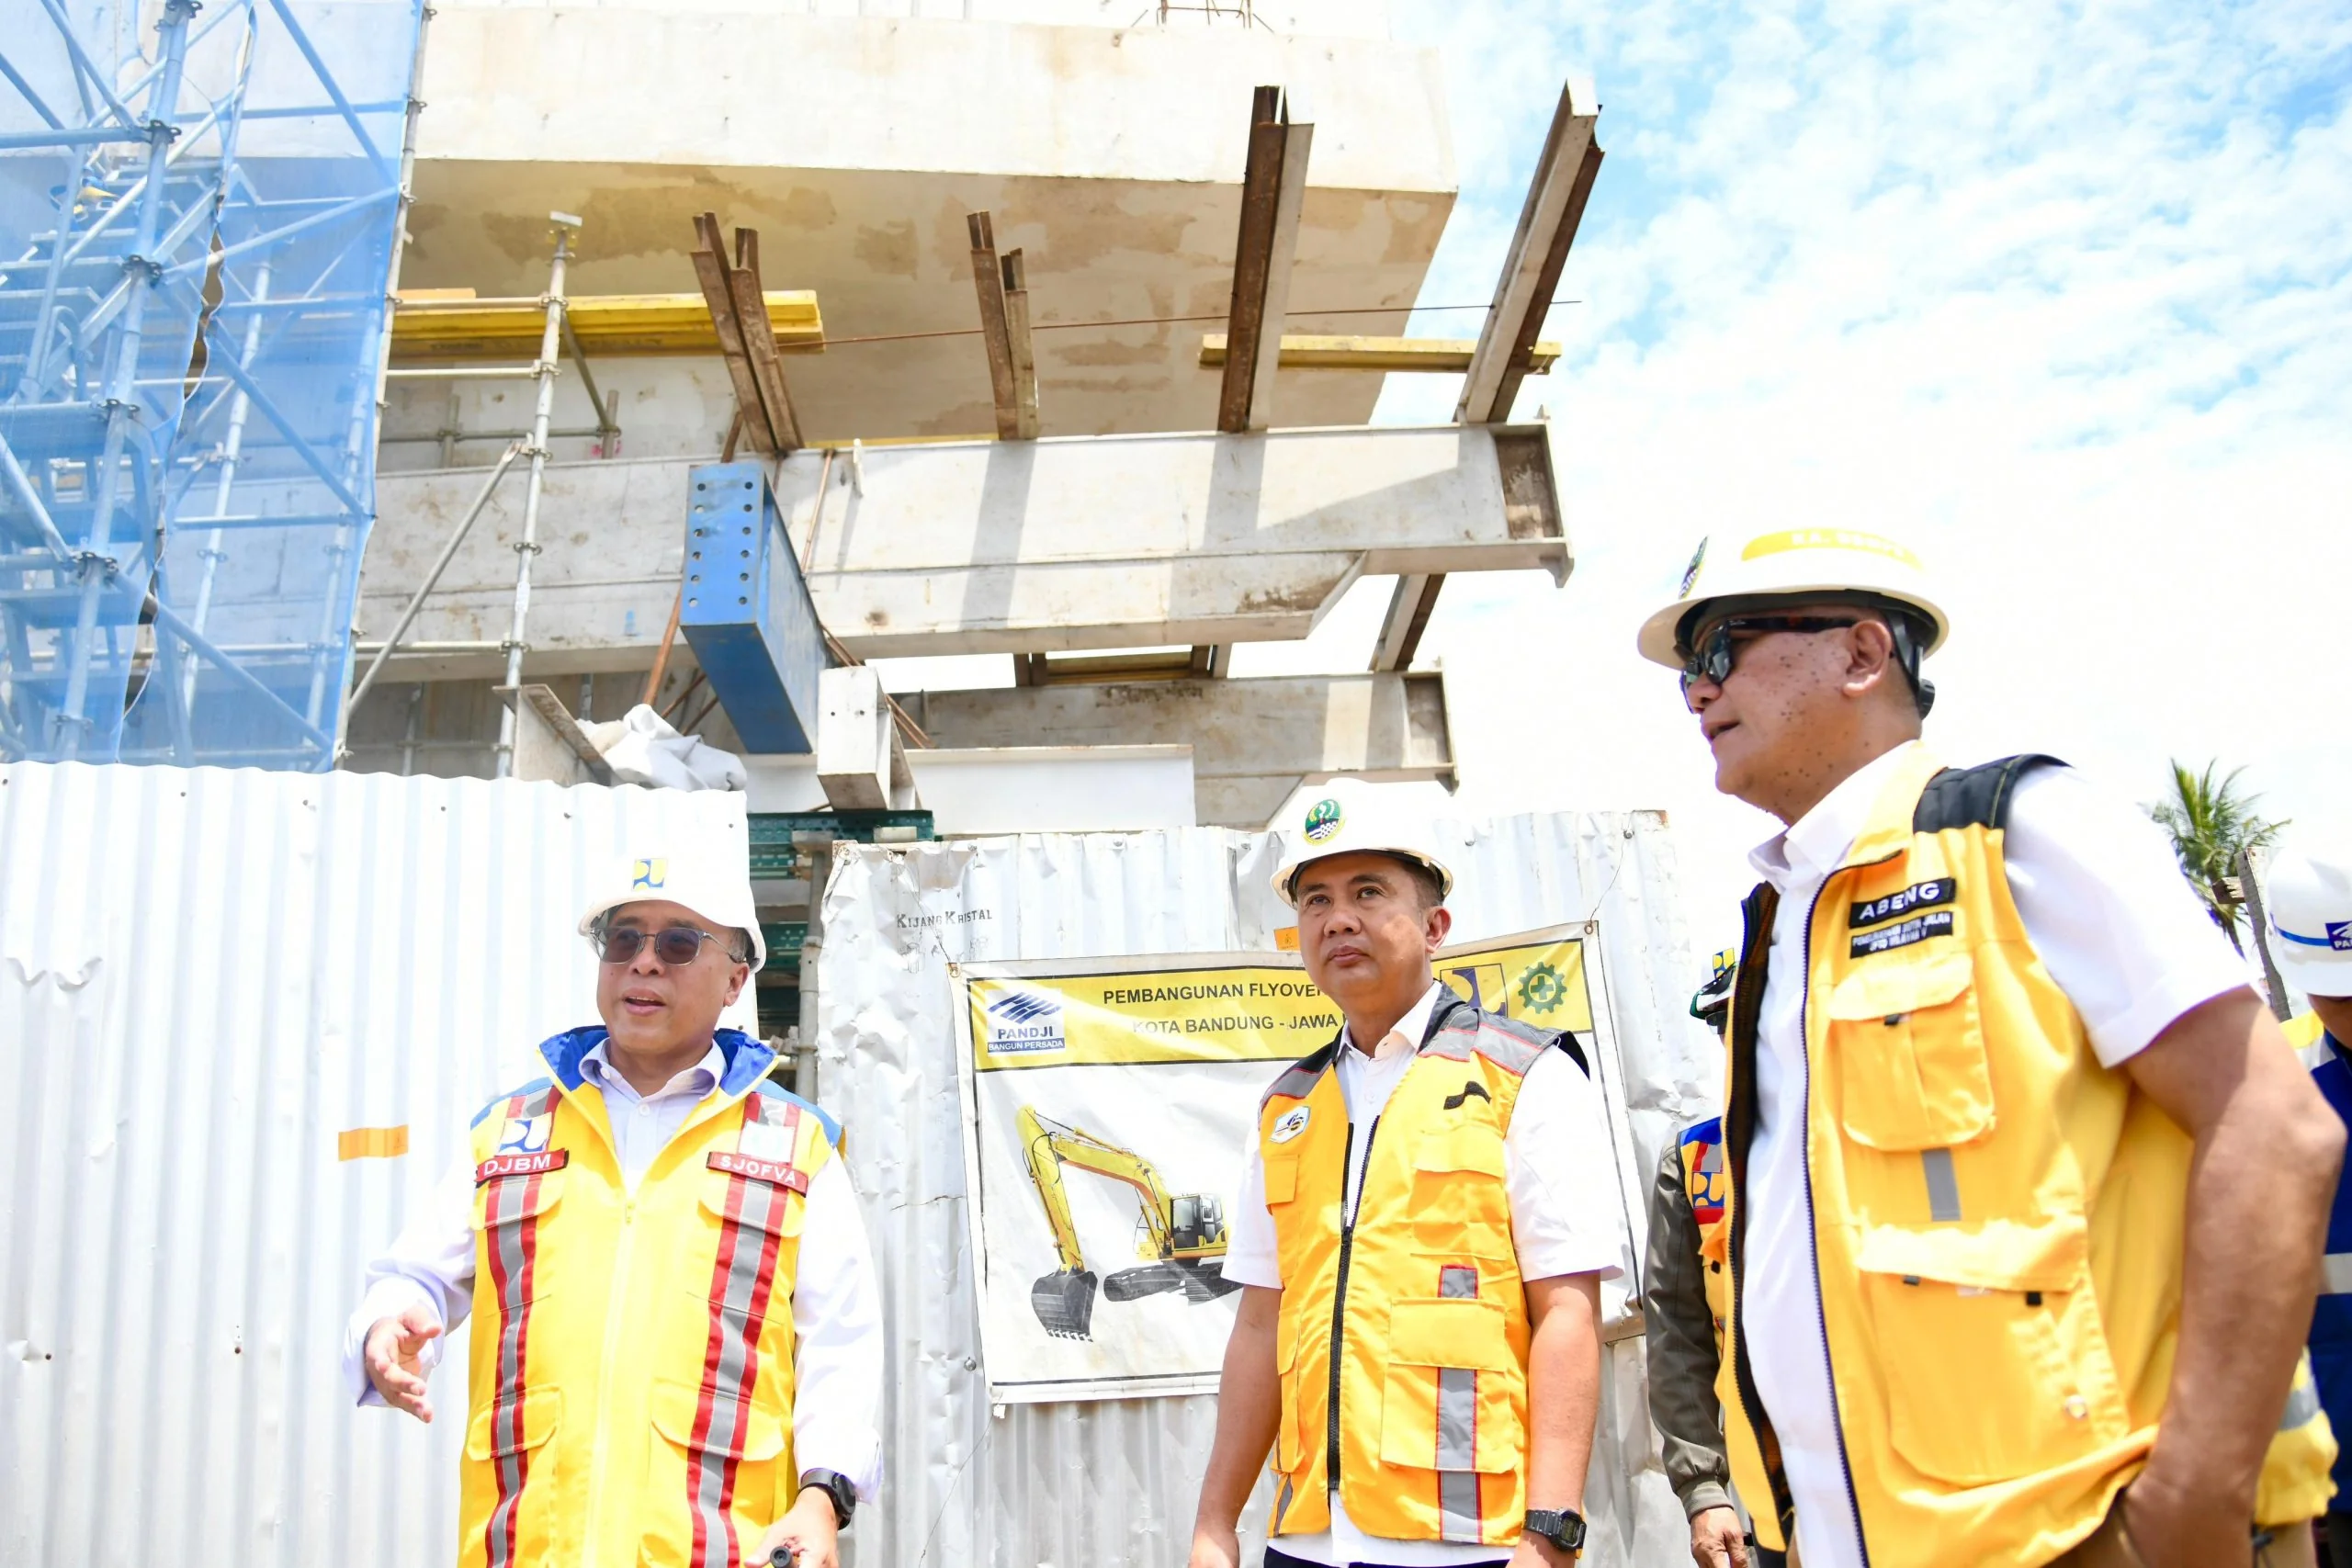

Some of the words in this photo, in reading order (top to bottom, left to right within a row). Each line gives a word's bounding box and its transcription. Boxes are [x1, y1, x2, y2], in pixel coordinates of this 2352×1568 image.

[1859, 883, 1939, 919] ABENG
[2335, 940, 2352, 949] PA
[1103, 984, 1244, 1004] PEMBANGUNAN
[998, 1026, 1053, 1039] PANDJI
[1133, 1020, 1181, 1034] KOTA
[1185, 1016, 1274, 1033] BANDUNG
[1289, 1013, 1339, 1029] JAWA
[989, 1041, 1023, 1051] BANGUN
[1024, 1040, 1063, 1049] PERSADA
[484, 1154, 551, 1176] DJBM
[720, 1156, 796, 1185] SJOFVA
